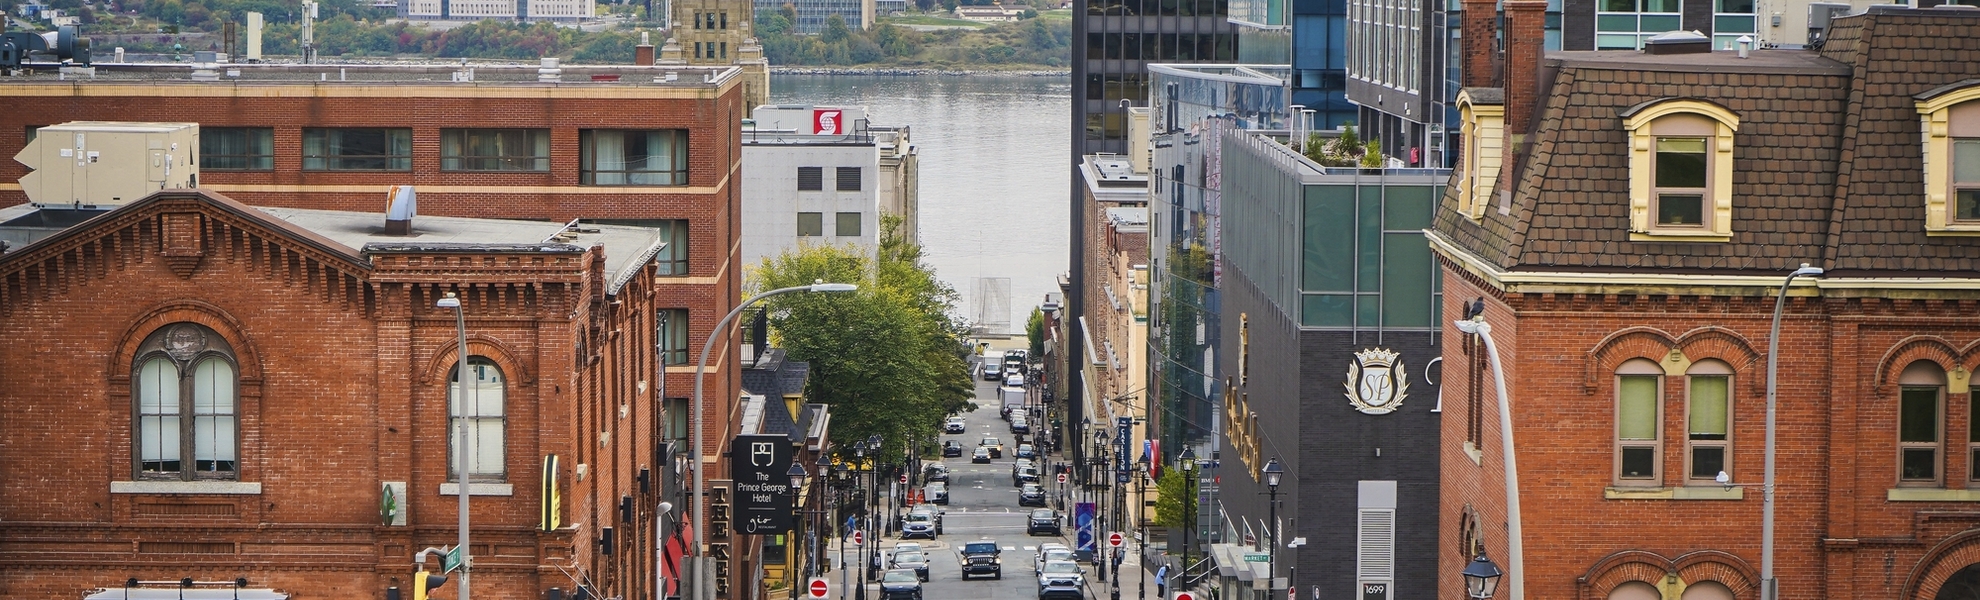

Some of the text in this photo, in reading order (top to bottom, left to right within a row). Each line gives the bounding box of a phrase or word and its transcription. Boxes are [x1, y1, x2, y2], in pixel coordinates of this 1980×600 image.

[756, 472, 769, 481] The
[737, 482, 787, 495] Prince George
[752, 494, 772, 503] Hotel
[711, 486, 730, 537] THE
[746, 515, 772, 533] gio
[711, 543, 730, 594] KEG
[1365, 585, 1384, 594] 1699
